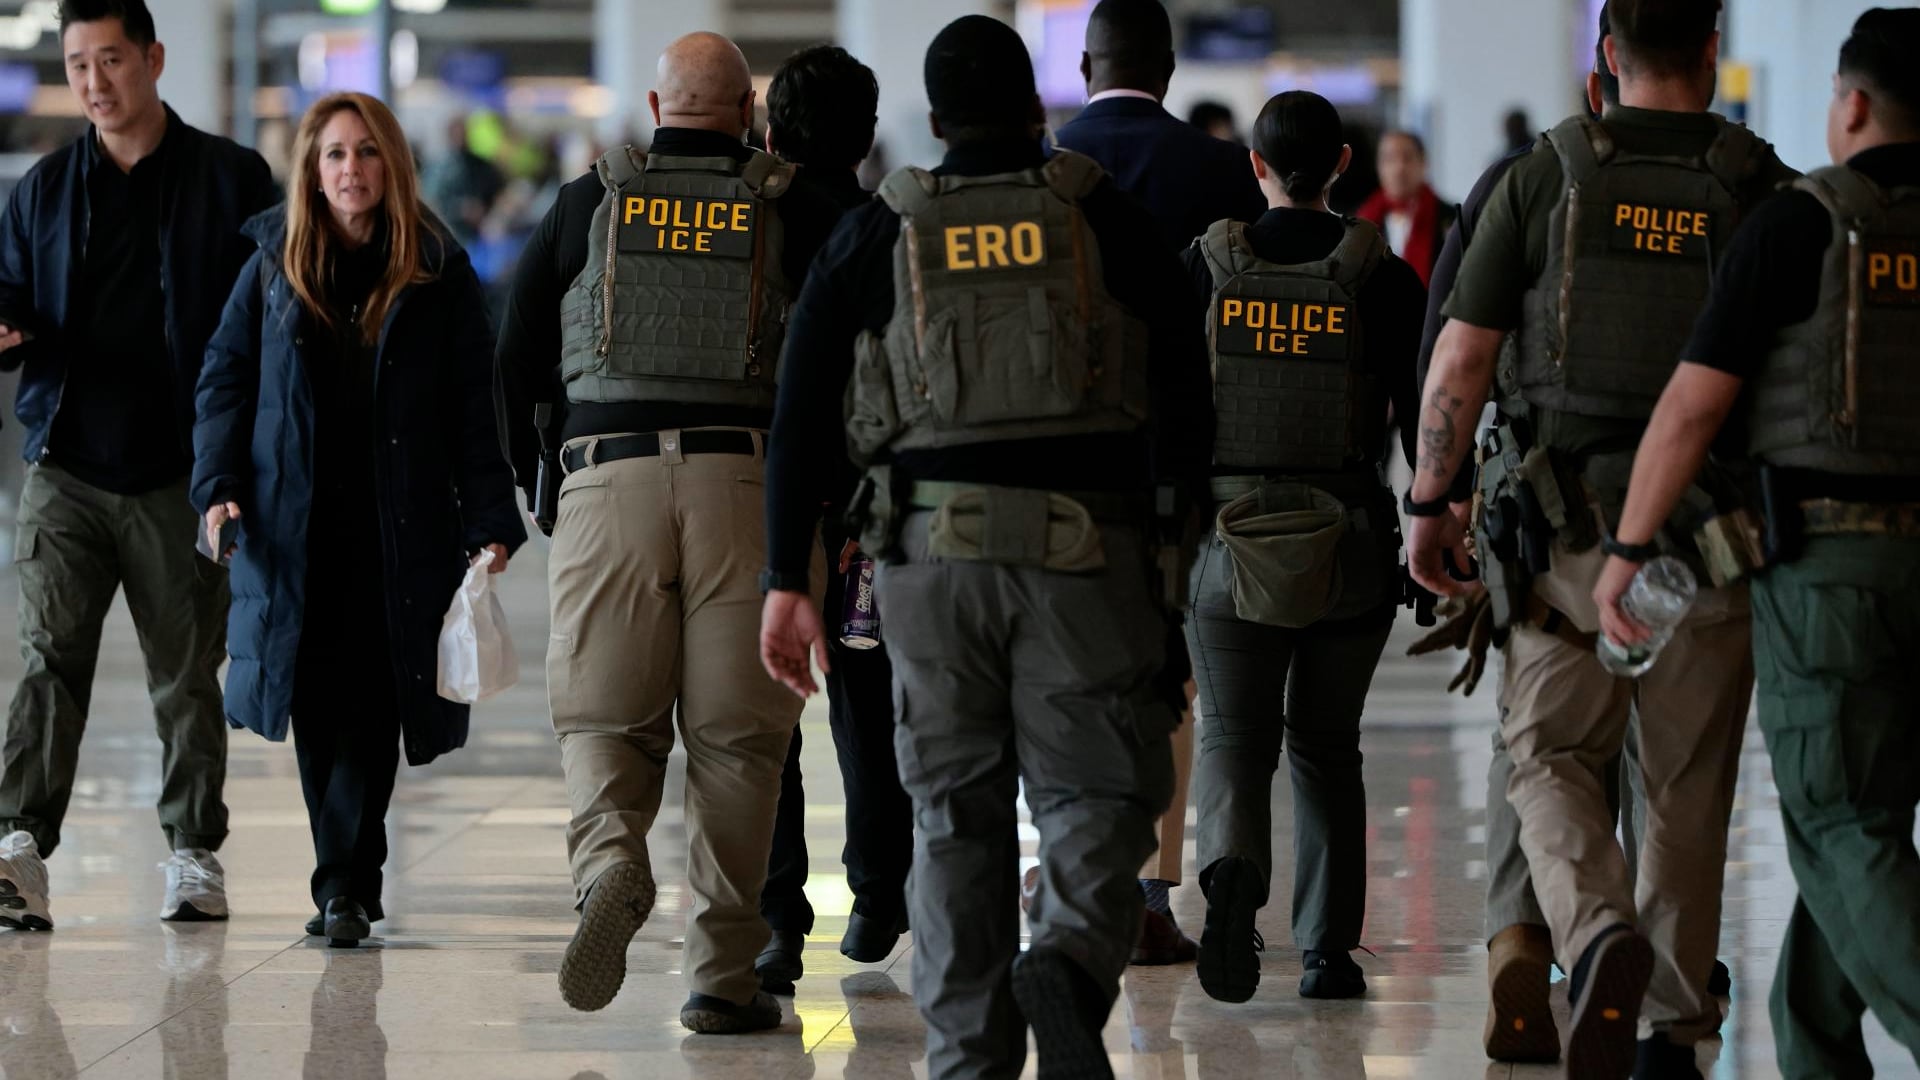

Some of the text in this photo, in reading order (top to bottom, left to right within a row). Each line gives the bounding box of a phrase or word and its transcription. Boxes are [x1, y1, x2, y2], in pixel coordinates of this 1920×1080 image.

[624, 196, 750, 231] POLICE
[1615, 203, 1708, 236] POLICE
[657, 229, 713, 252] ICE
[944, 221, 1043, 271] ERO
[1635, 231, 1684, 254] ICE
[1223, 299, 1346, 334] POLICE
[1256, 331, 1310, 354] ICE
[855, 575, 874, 616] GHOST
